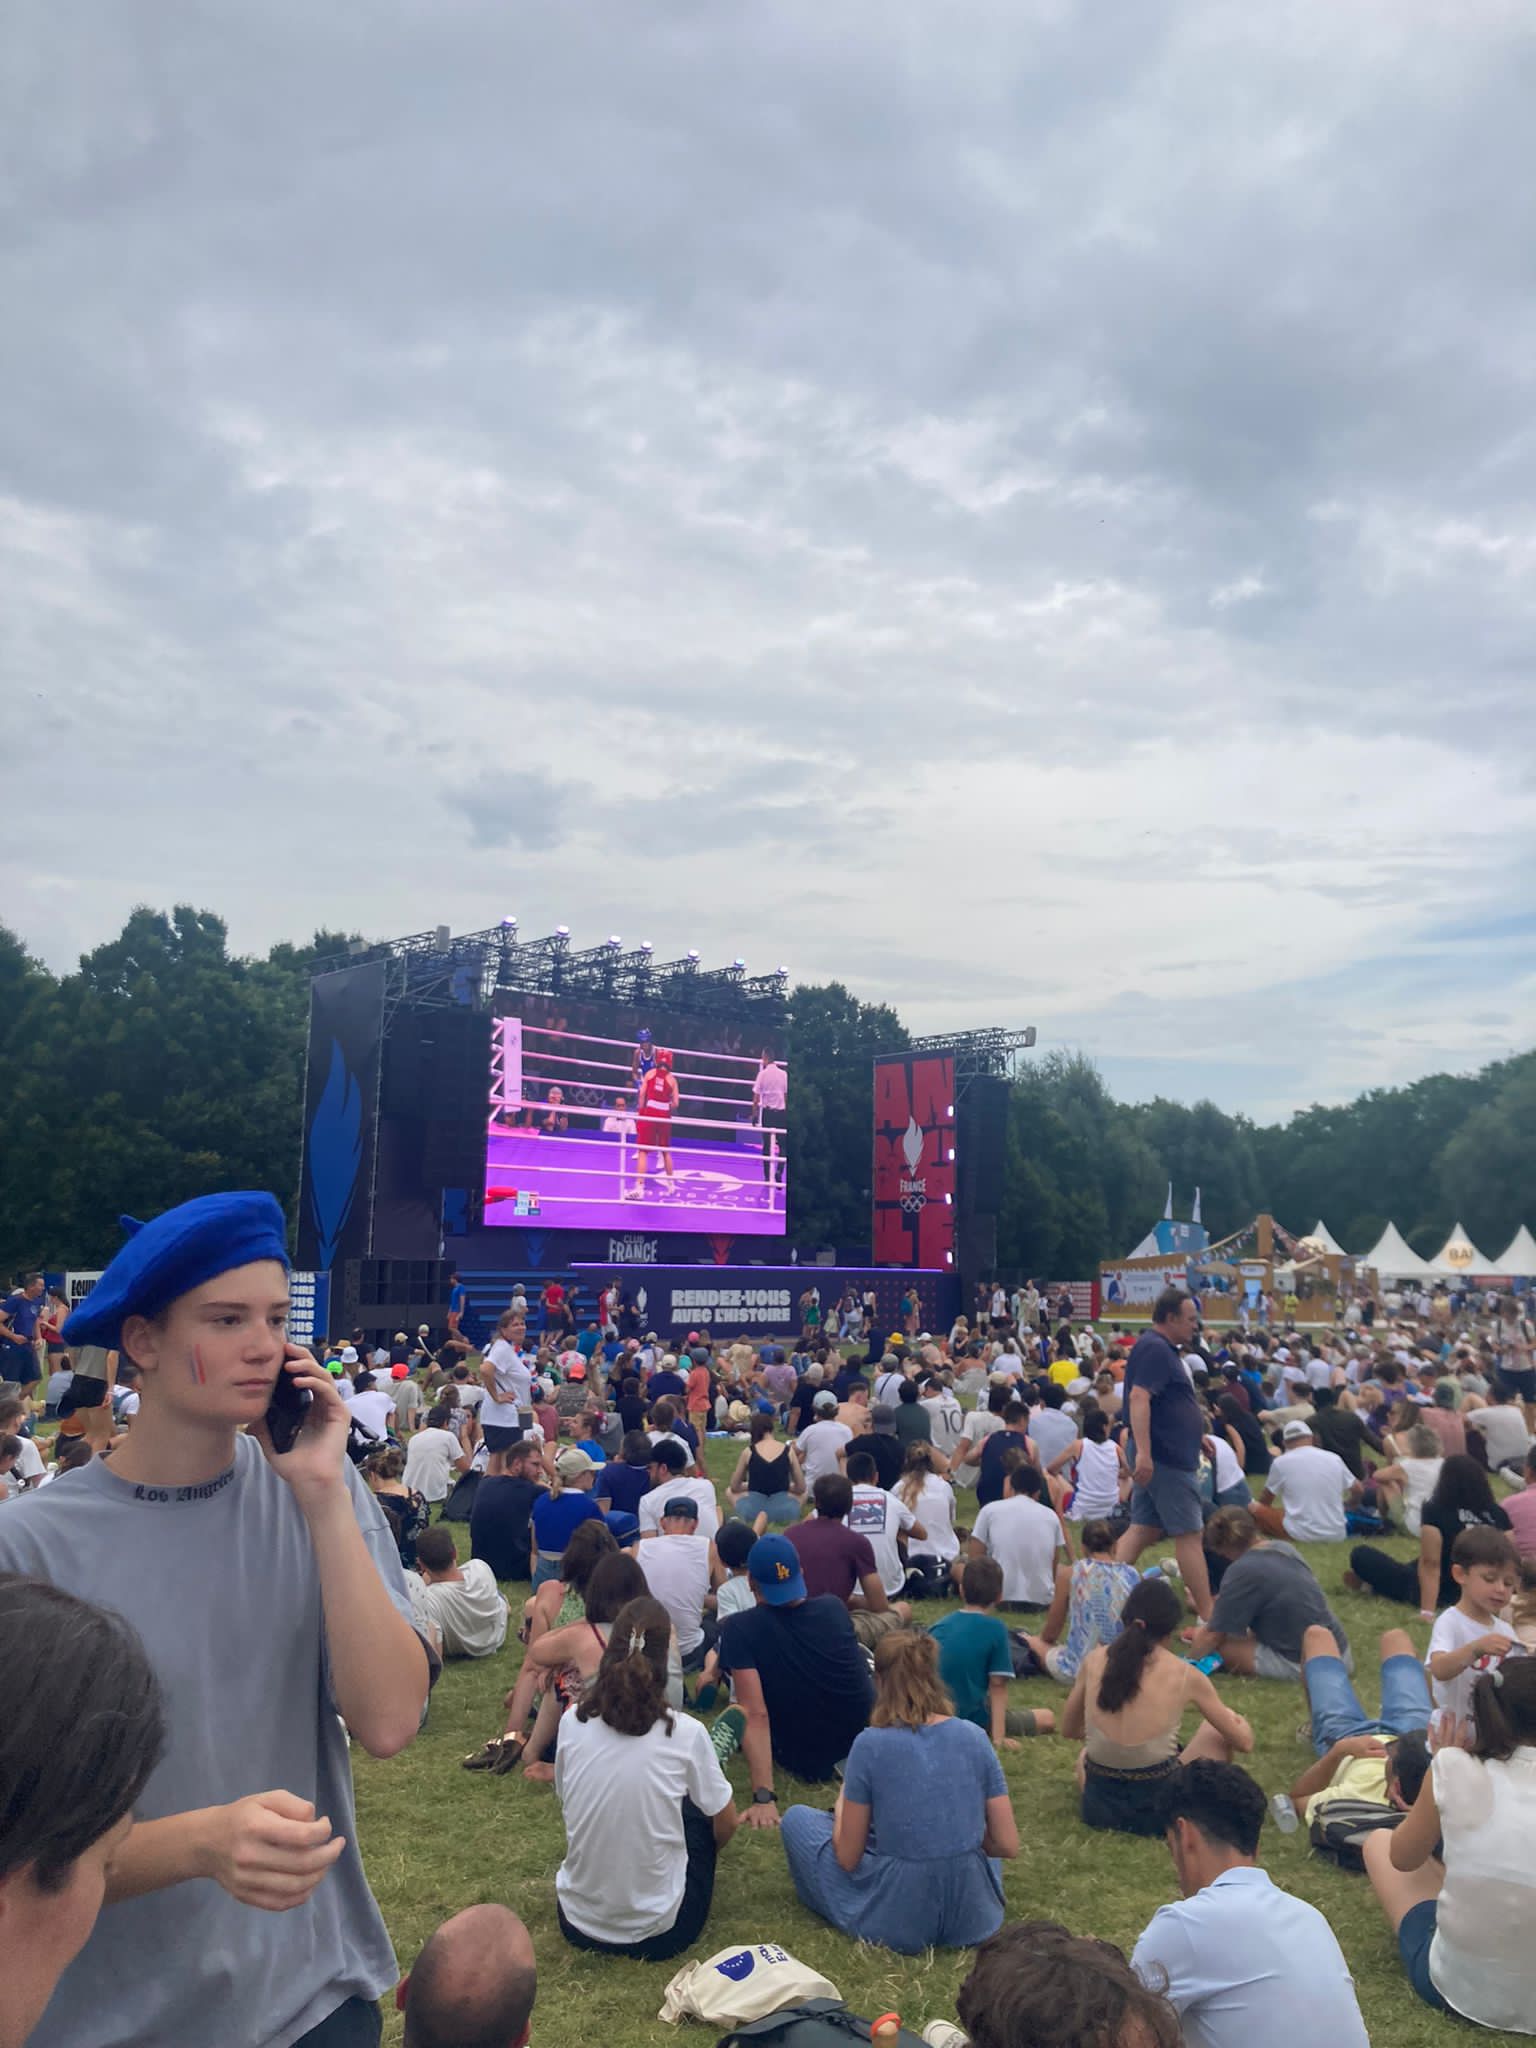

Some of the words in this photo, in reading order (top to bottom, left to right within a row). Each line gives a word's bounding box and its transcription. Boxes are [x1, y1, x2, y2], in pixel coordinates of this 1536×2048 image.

[900, 1178, 926, 1192] FRANCE
[609, 1237, 657, 1263] FRANCE
[671, 1289, 791, 1307] RENDEZ-VOUS
[671, 1308, 712, 1323] AVEC
[714, 1307, 791, 1323] L'HISTOIRE
[940, 1409, 962, 1434] 10
[134, 1485, 169, 1502] Los
[775, 1561, 790, 1580] LA
